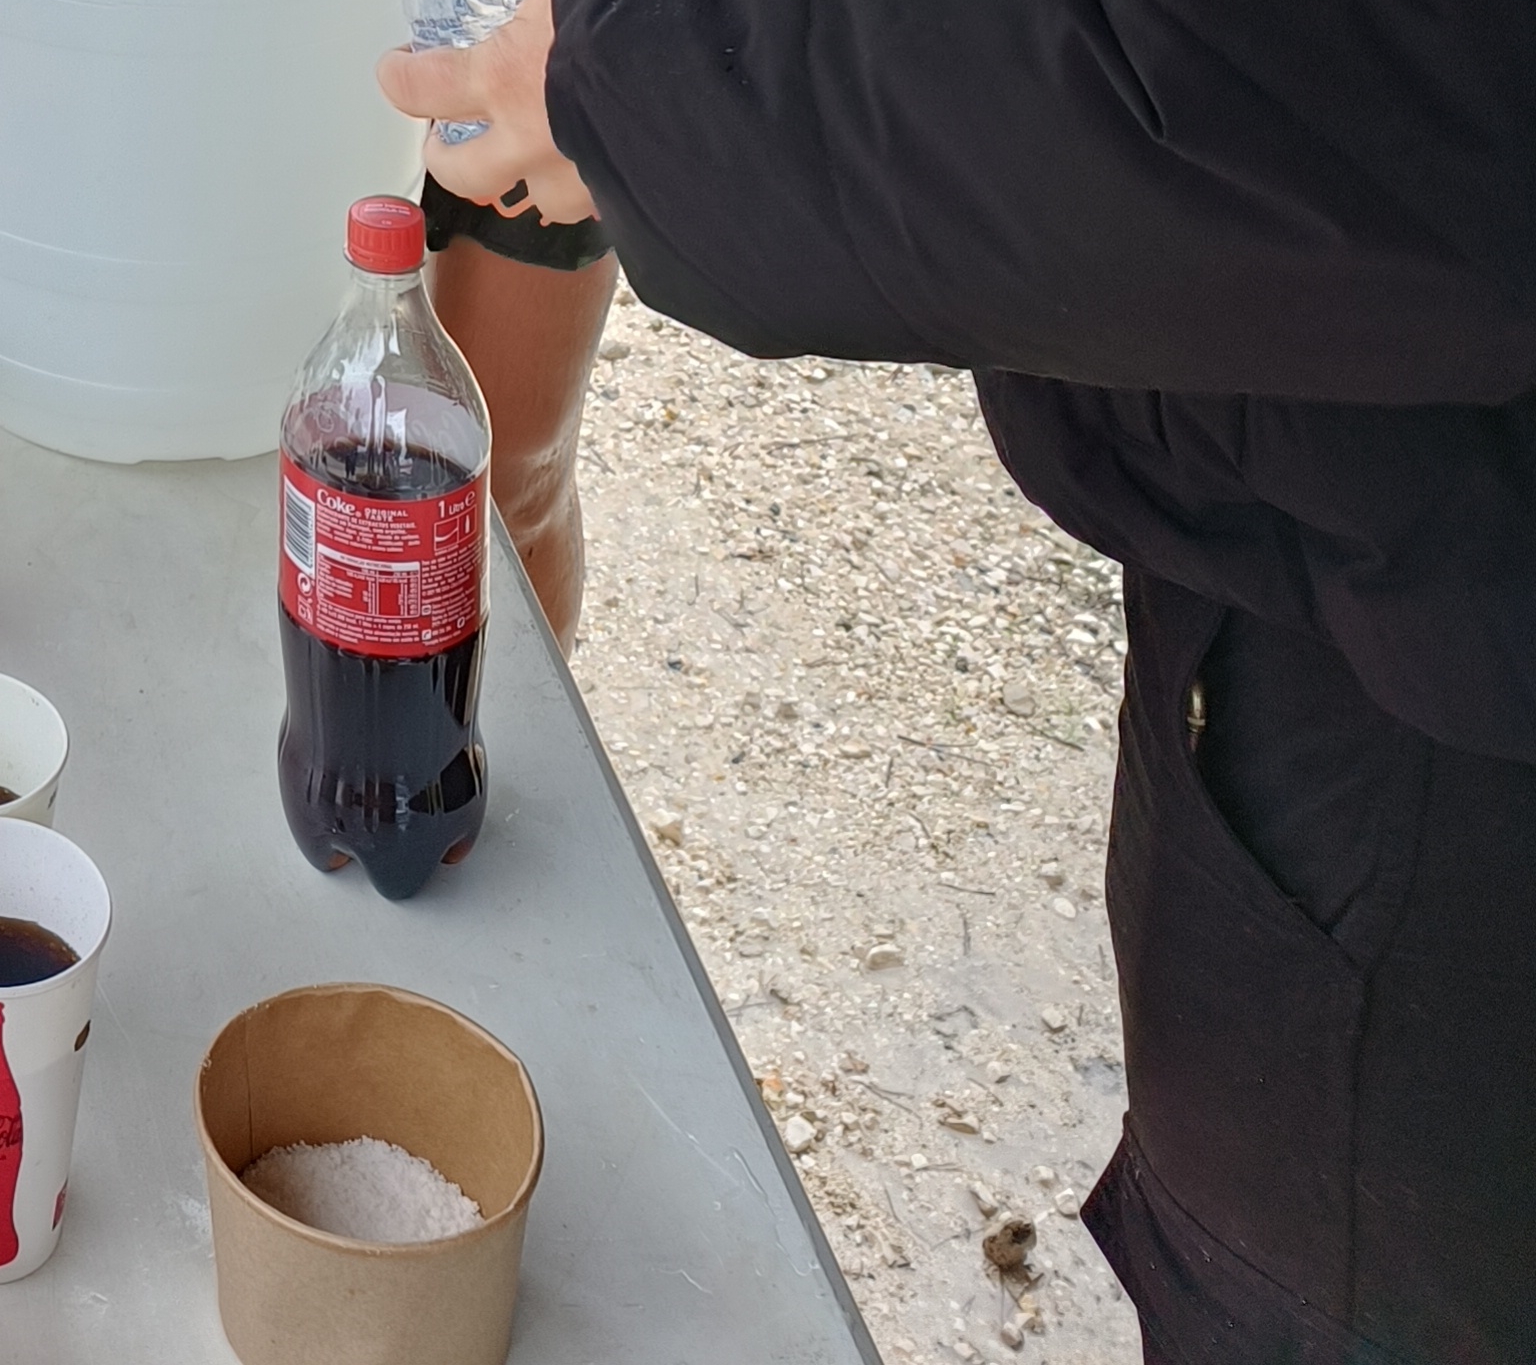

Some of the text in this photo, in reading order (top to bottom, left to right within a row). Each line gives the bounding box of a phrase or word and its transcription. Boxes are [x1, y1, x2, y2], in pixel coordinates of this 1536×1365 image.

[317, 488, 356, 516] Coke
[438, 499, 445, 518] 1
[448, 500, 465, 515] Litro
[363, 507, 408, 518] ORIGINAL
